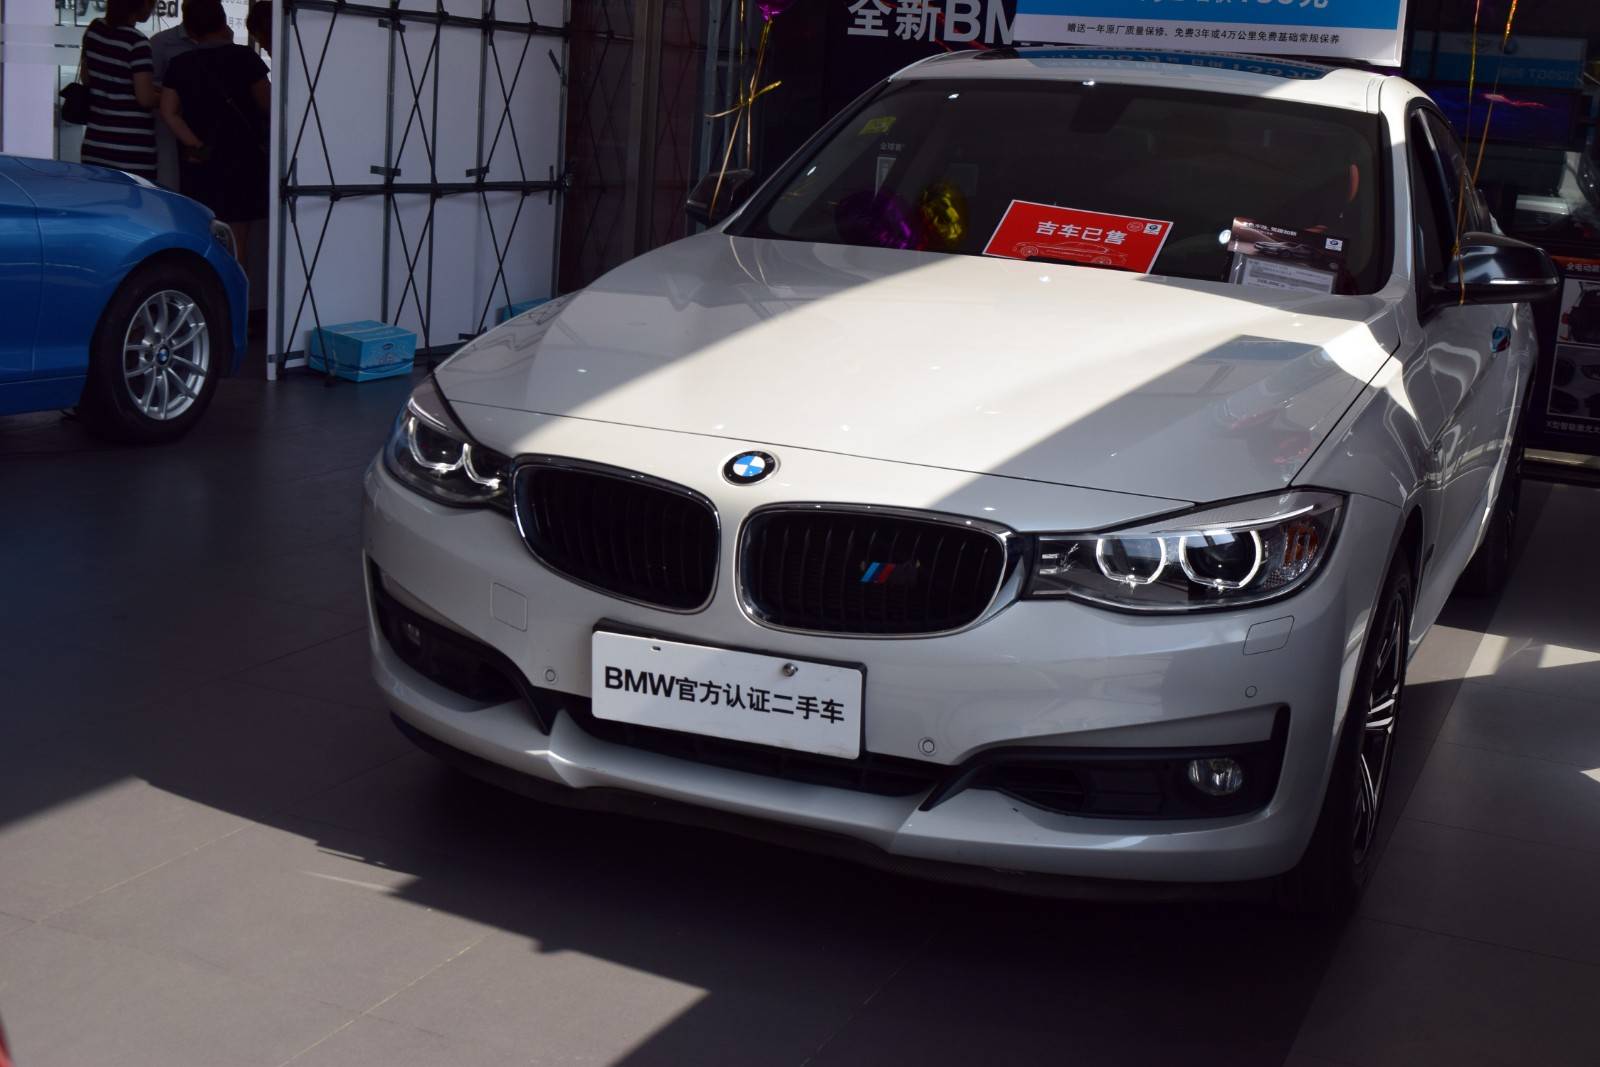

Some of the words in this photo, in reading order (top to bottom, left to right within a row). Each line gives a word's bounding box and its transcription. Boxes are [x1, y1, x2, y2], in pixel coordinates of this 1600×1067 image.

[1035, 220, 1128, 246] 吉车已售
[603, 665, 845, 724] BMW官方认证二手车
